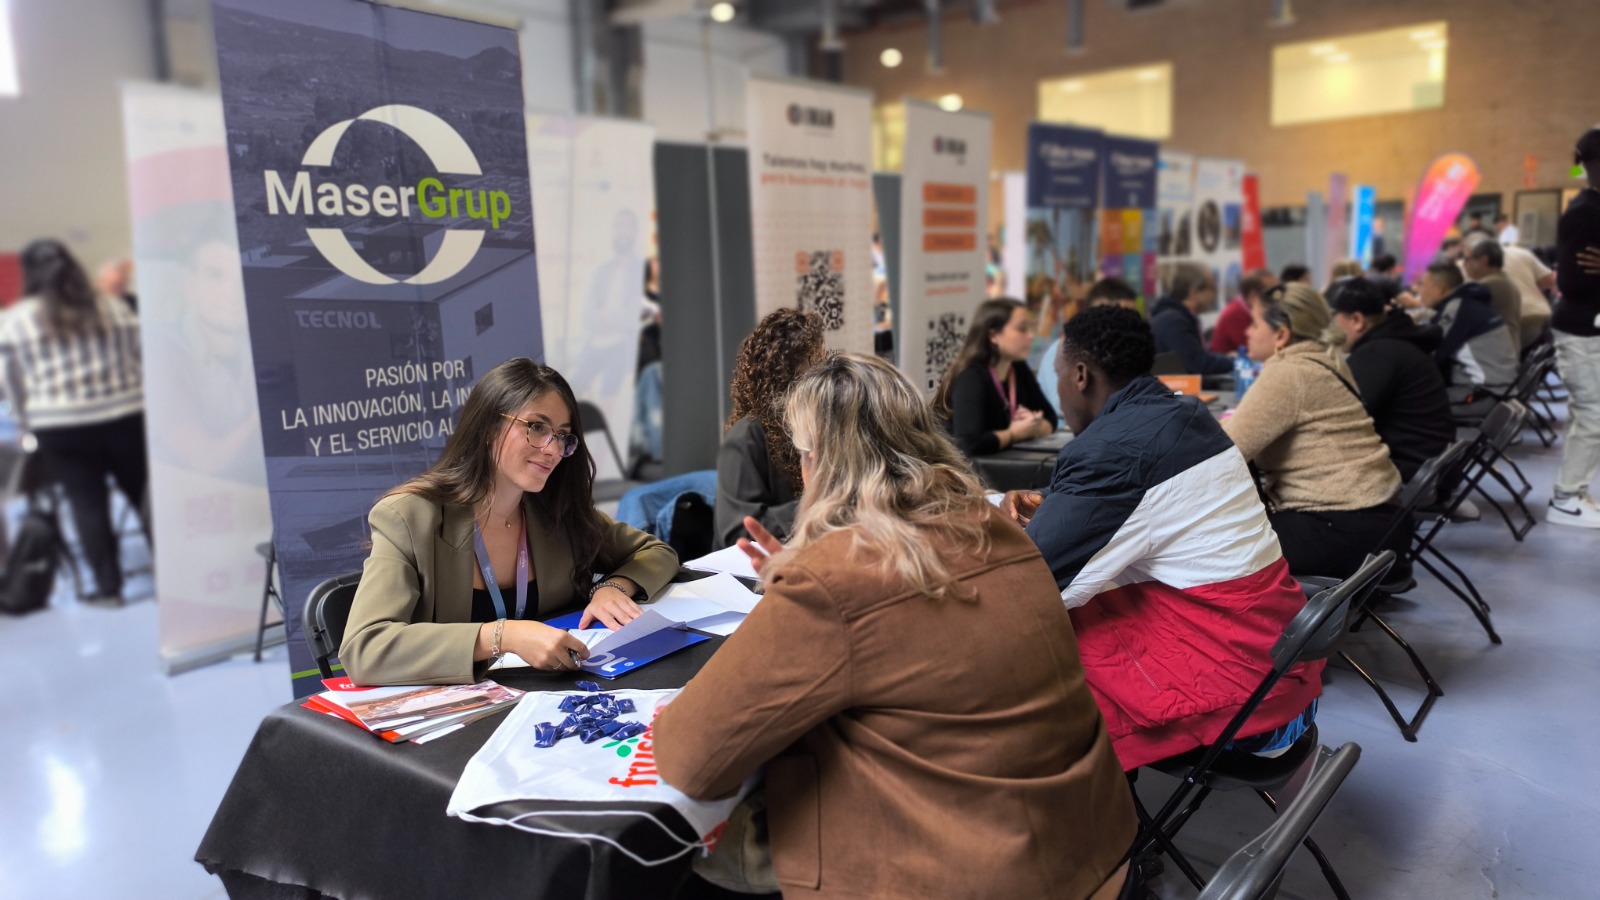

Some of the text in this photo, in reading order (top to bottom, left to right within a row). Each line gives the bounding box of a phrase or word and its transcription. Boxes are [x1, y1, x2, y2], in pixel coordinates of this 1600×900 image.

[264, 170, 512, 229] MaserGrup
[295, 310, 382, 329] TECNOL
[366, 360, 466, 388] PASIÓN POR
[281, 408, 308, 430] LA
[313, 391, 427, 426] INNOVACIÓN,
[431, 390, 452, 409] LA
[309, 418, 455, 457] Y EL SERVICIO AL
